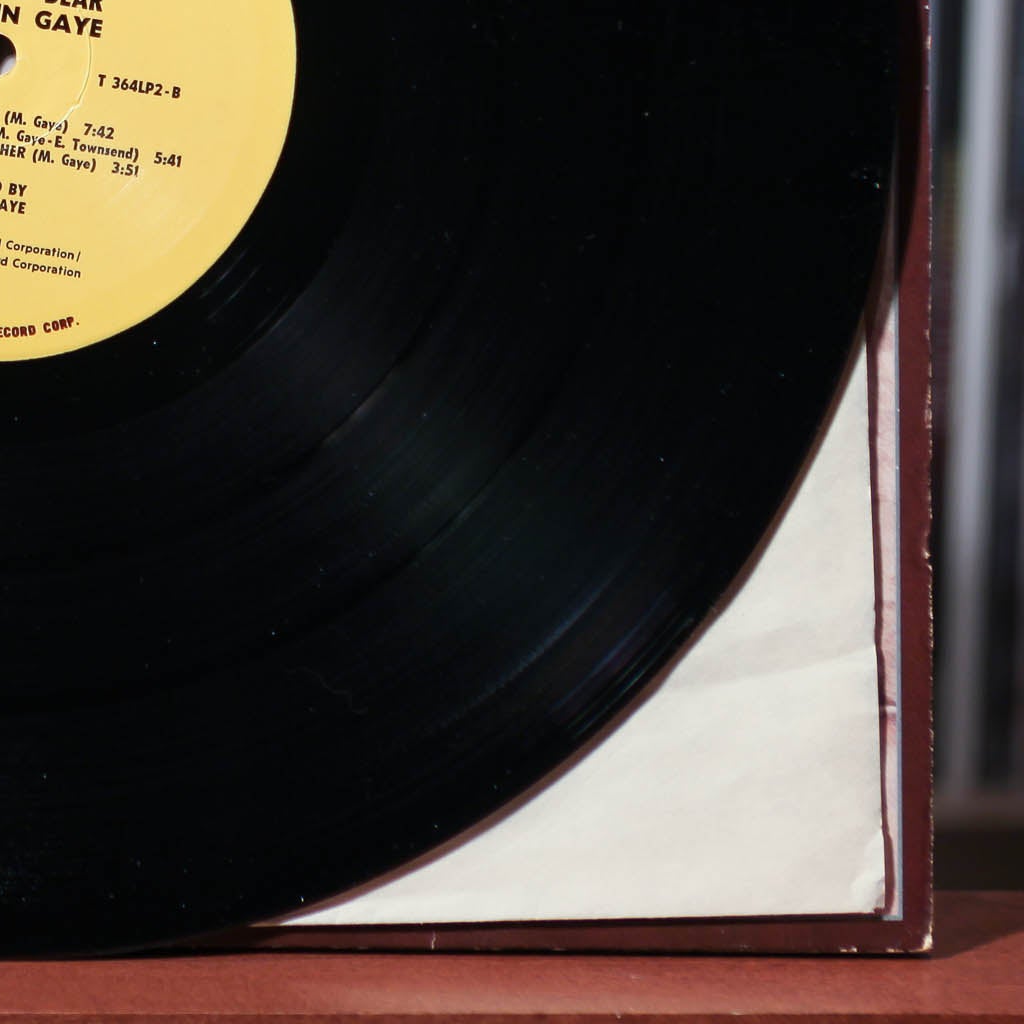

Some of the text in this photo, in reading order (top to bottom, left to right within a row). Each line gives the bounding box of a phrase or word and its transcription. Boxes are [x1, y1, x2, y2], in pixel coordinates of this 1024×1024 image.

[35, 11, 103, 38] GAYE
[98, 74, 106, 87] T
[5, 111, 26, 125] (M.
[84, 123, 114, 139] 7:42
[33, 149, 54, 163] (M.
[62, 154, 96, 172] Gaye)
[112, 162, 139, 177] 3:51
[73, 138, 139, 163] Townsend)
[154, 152, 181, 167] 5:41
[8, 183, 27, 197] BY
[13, 259, 81, 278] Corporation
[43, 316, 79, 333] CORP.
